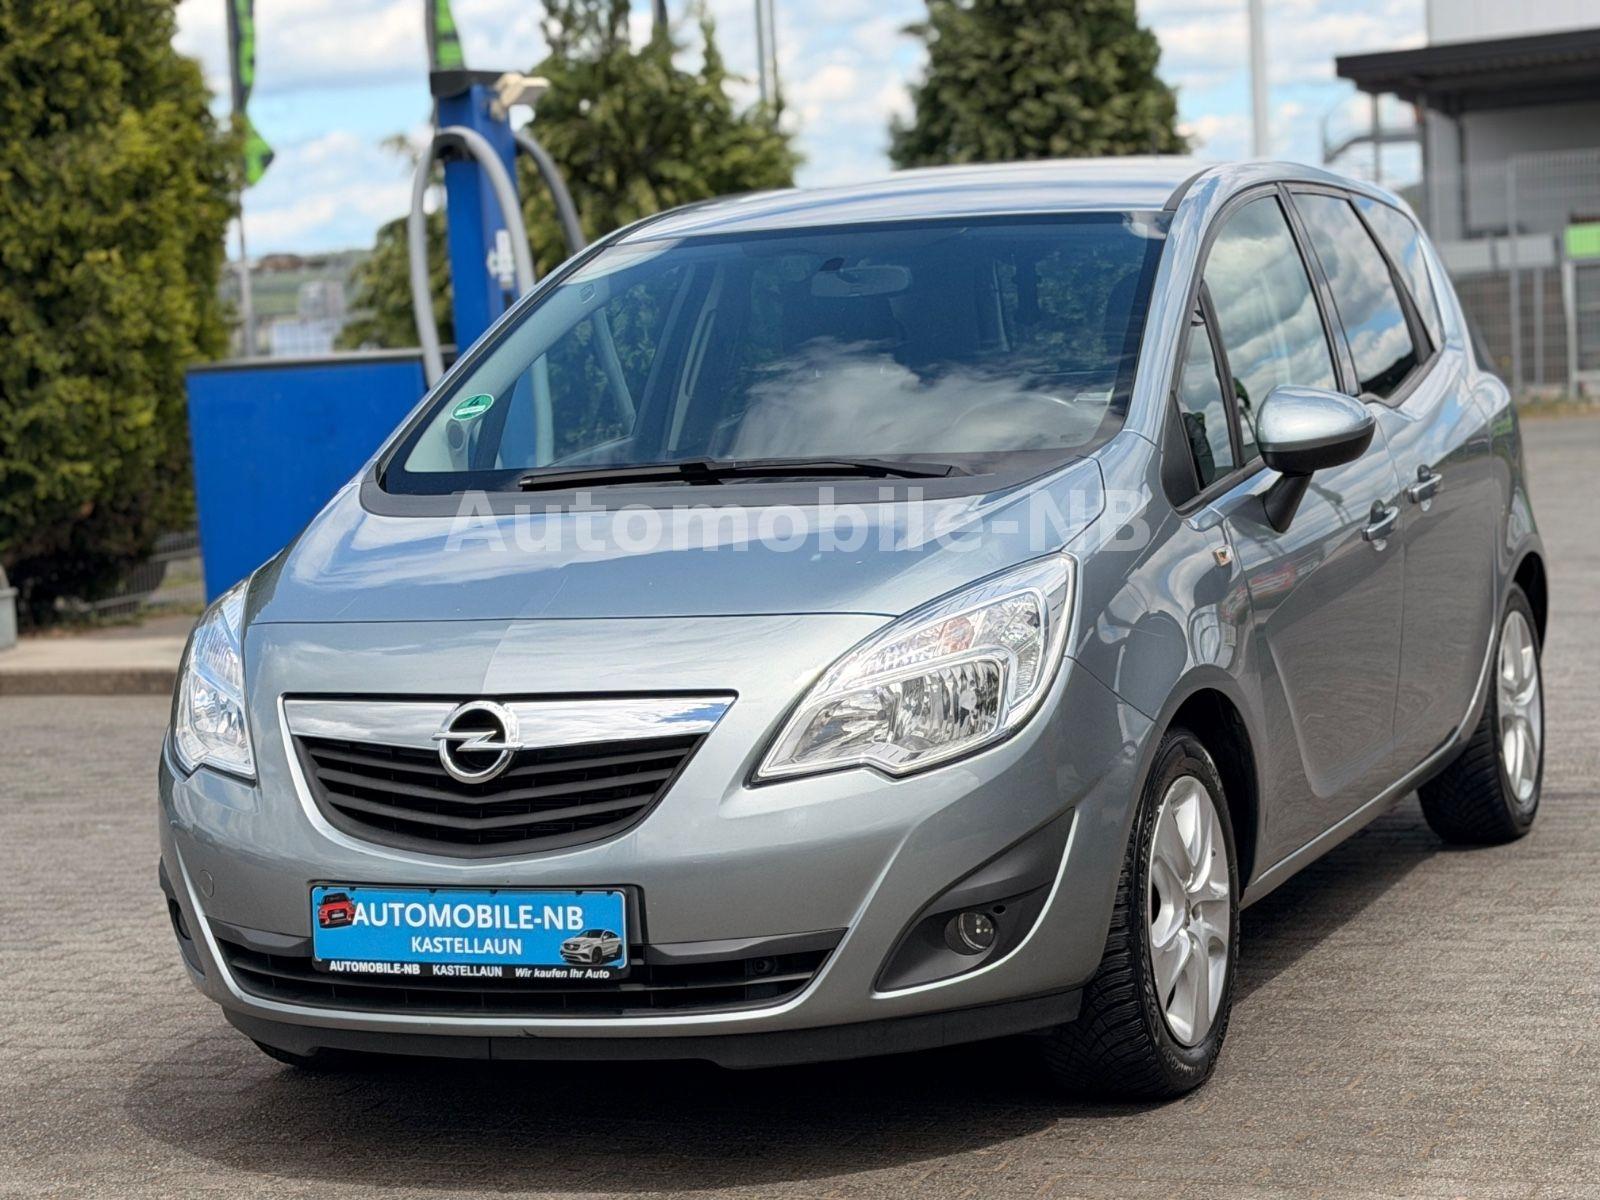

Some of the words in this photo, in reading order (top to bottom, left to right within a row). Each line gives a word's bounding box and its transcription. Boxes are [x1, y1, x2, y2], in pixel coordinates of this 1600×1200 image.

[352, 902, 584, 931] AUTOMOBILE-NB
[411, 936, 522, 956] KASTELLAUN
[329, 960, 420, 975] AUTOMOBILE-NB
[432, 964, 502, 977] KASTELLAUN
[515, 967, 532, 978] Wir
[533, 967, 568, 979] kaufen
[569, 968, 584, 979] Ihr
[585, 968, 610, 979] Auto
